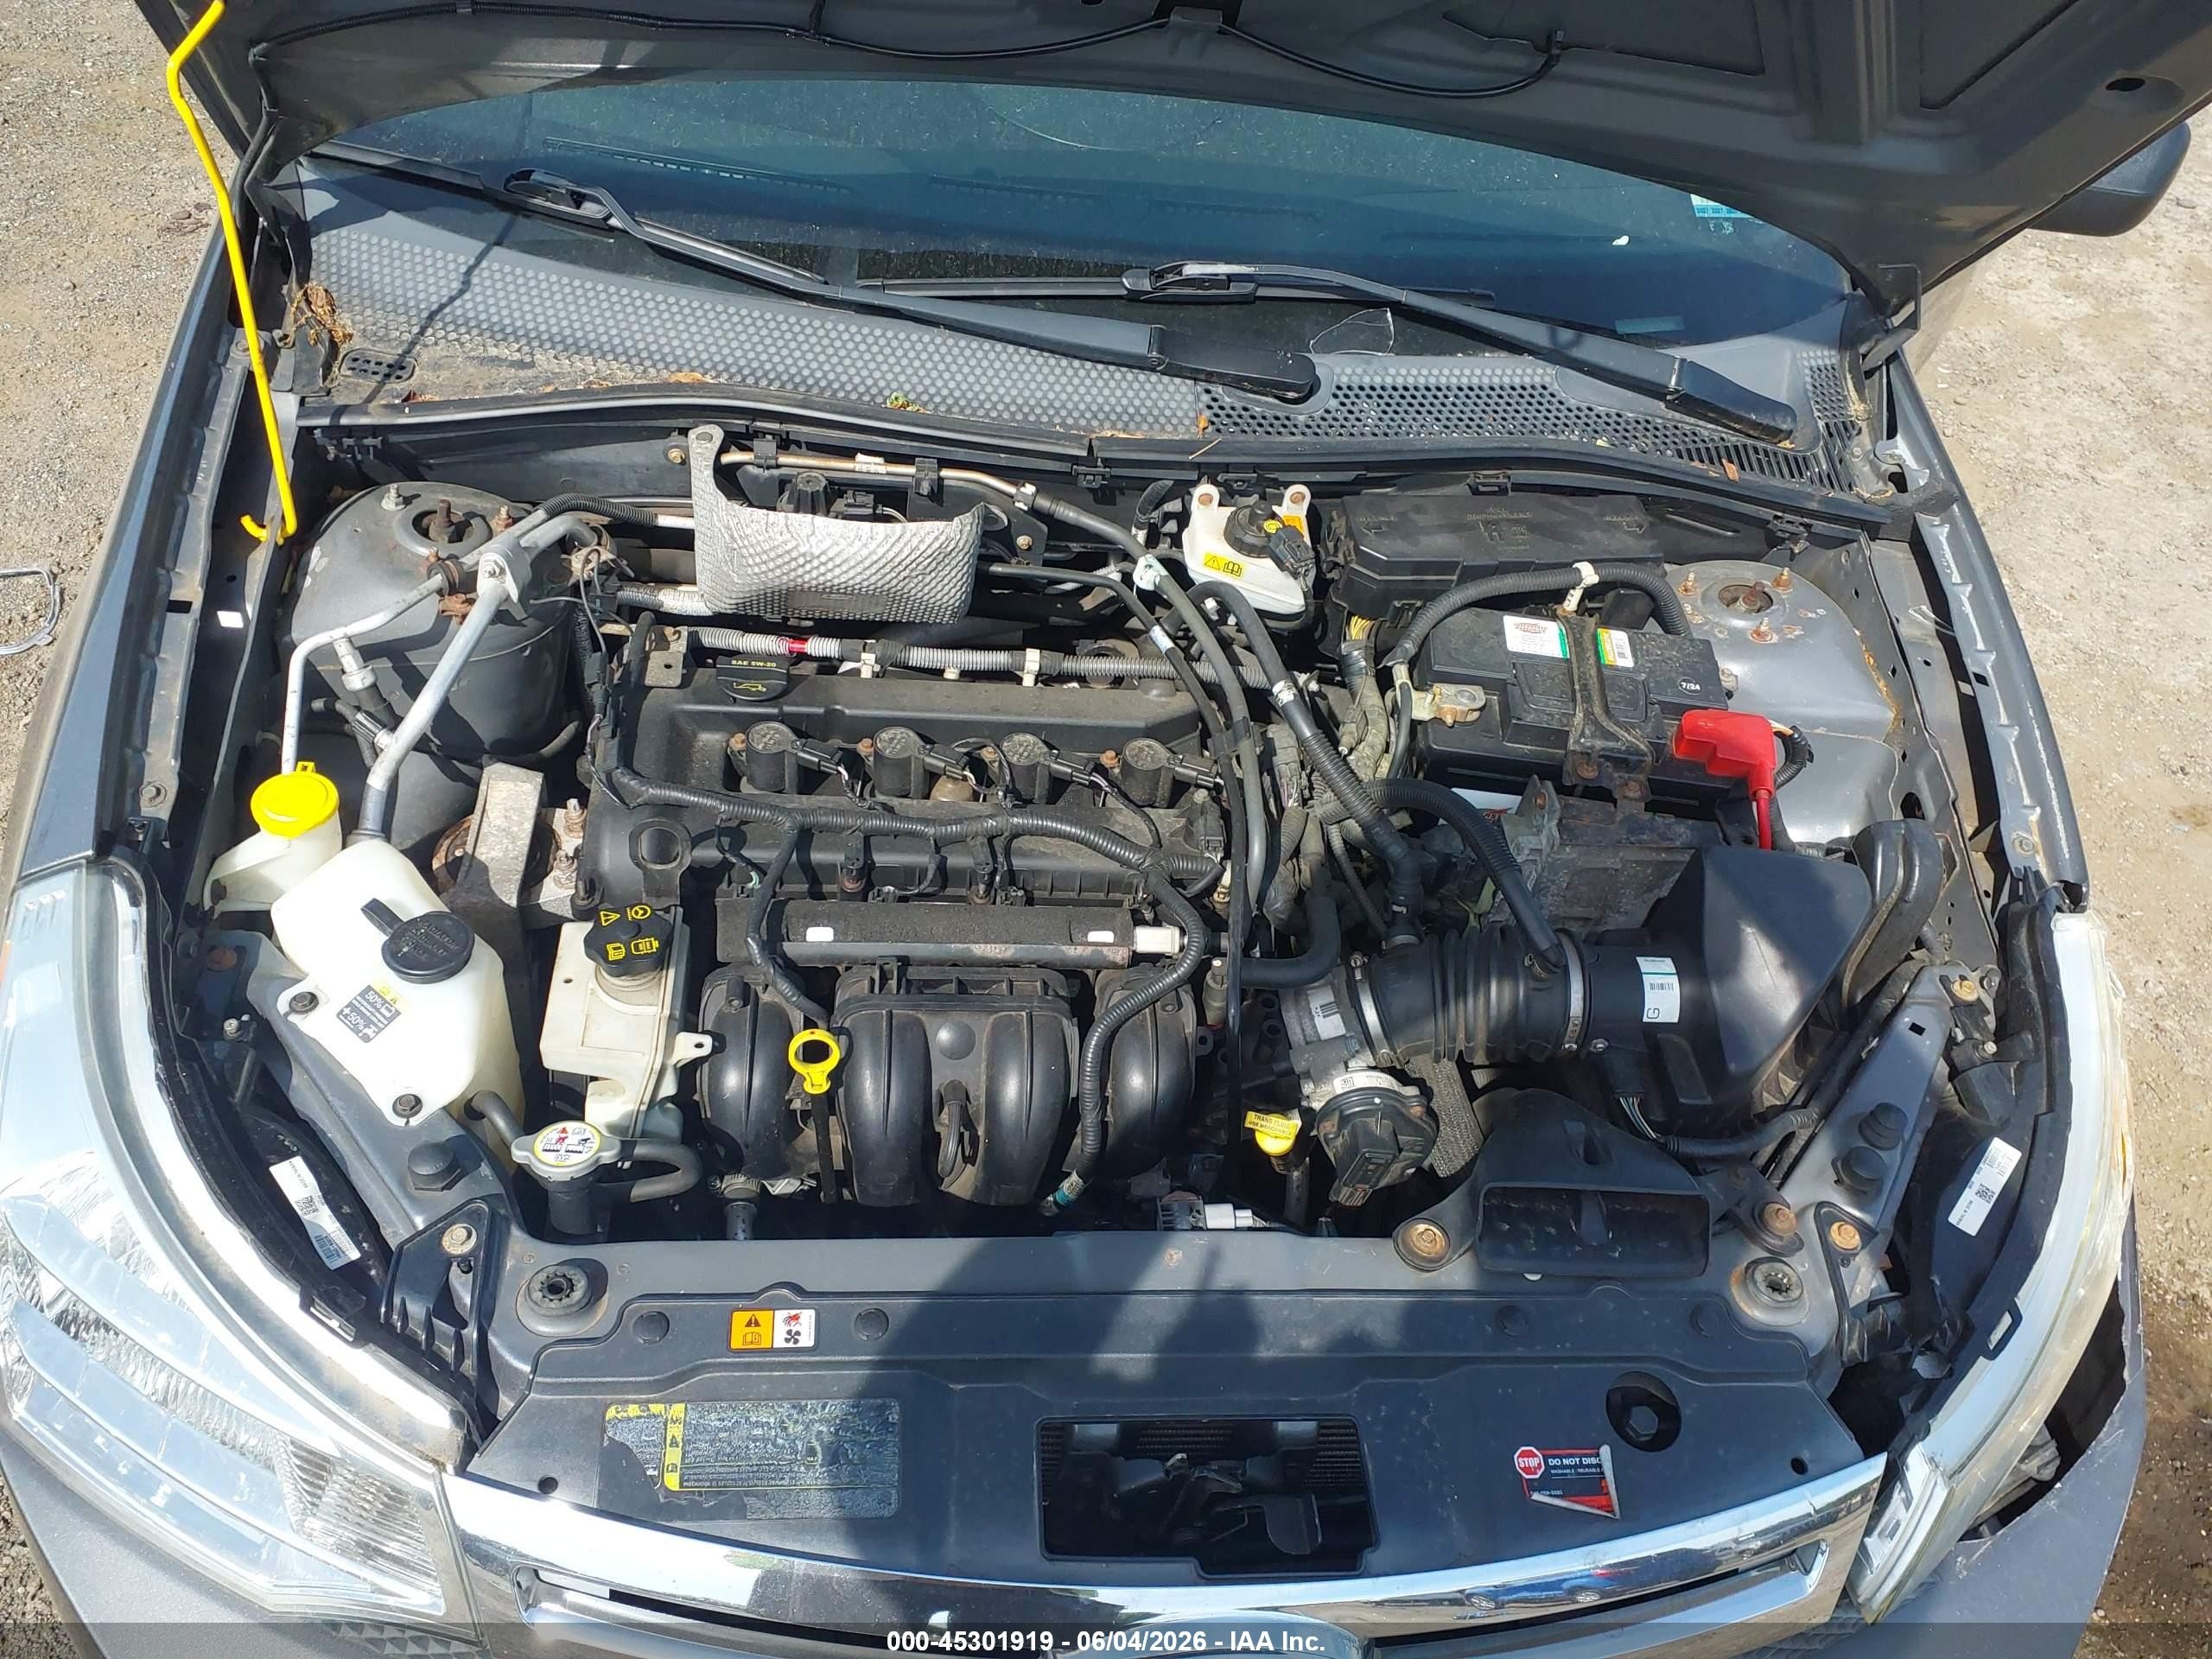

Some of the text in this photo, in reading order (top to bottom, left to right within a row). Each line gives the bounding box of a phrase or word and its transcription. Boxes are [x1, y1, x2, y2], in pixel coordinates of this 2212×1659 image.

[365, 990, 385, 1008] 50%
[1646, 1007, 1660, 1020] G
[1254, 1114, 1291, 1129] TRANS FLUID
[1518, 1457, 1540, 1468] STOP
[1548, 1458, 1561, 1466] DO
[1563, 1457, 1580, 1465] NOT
